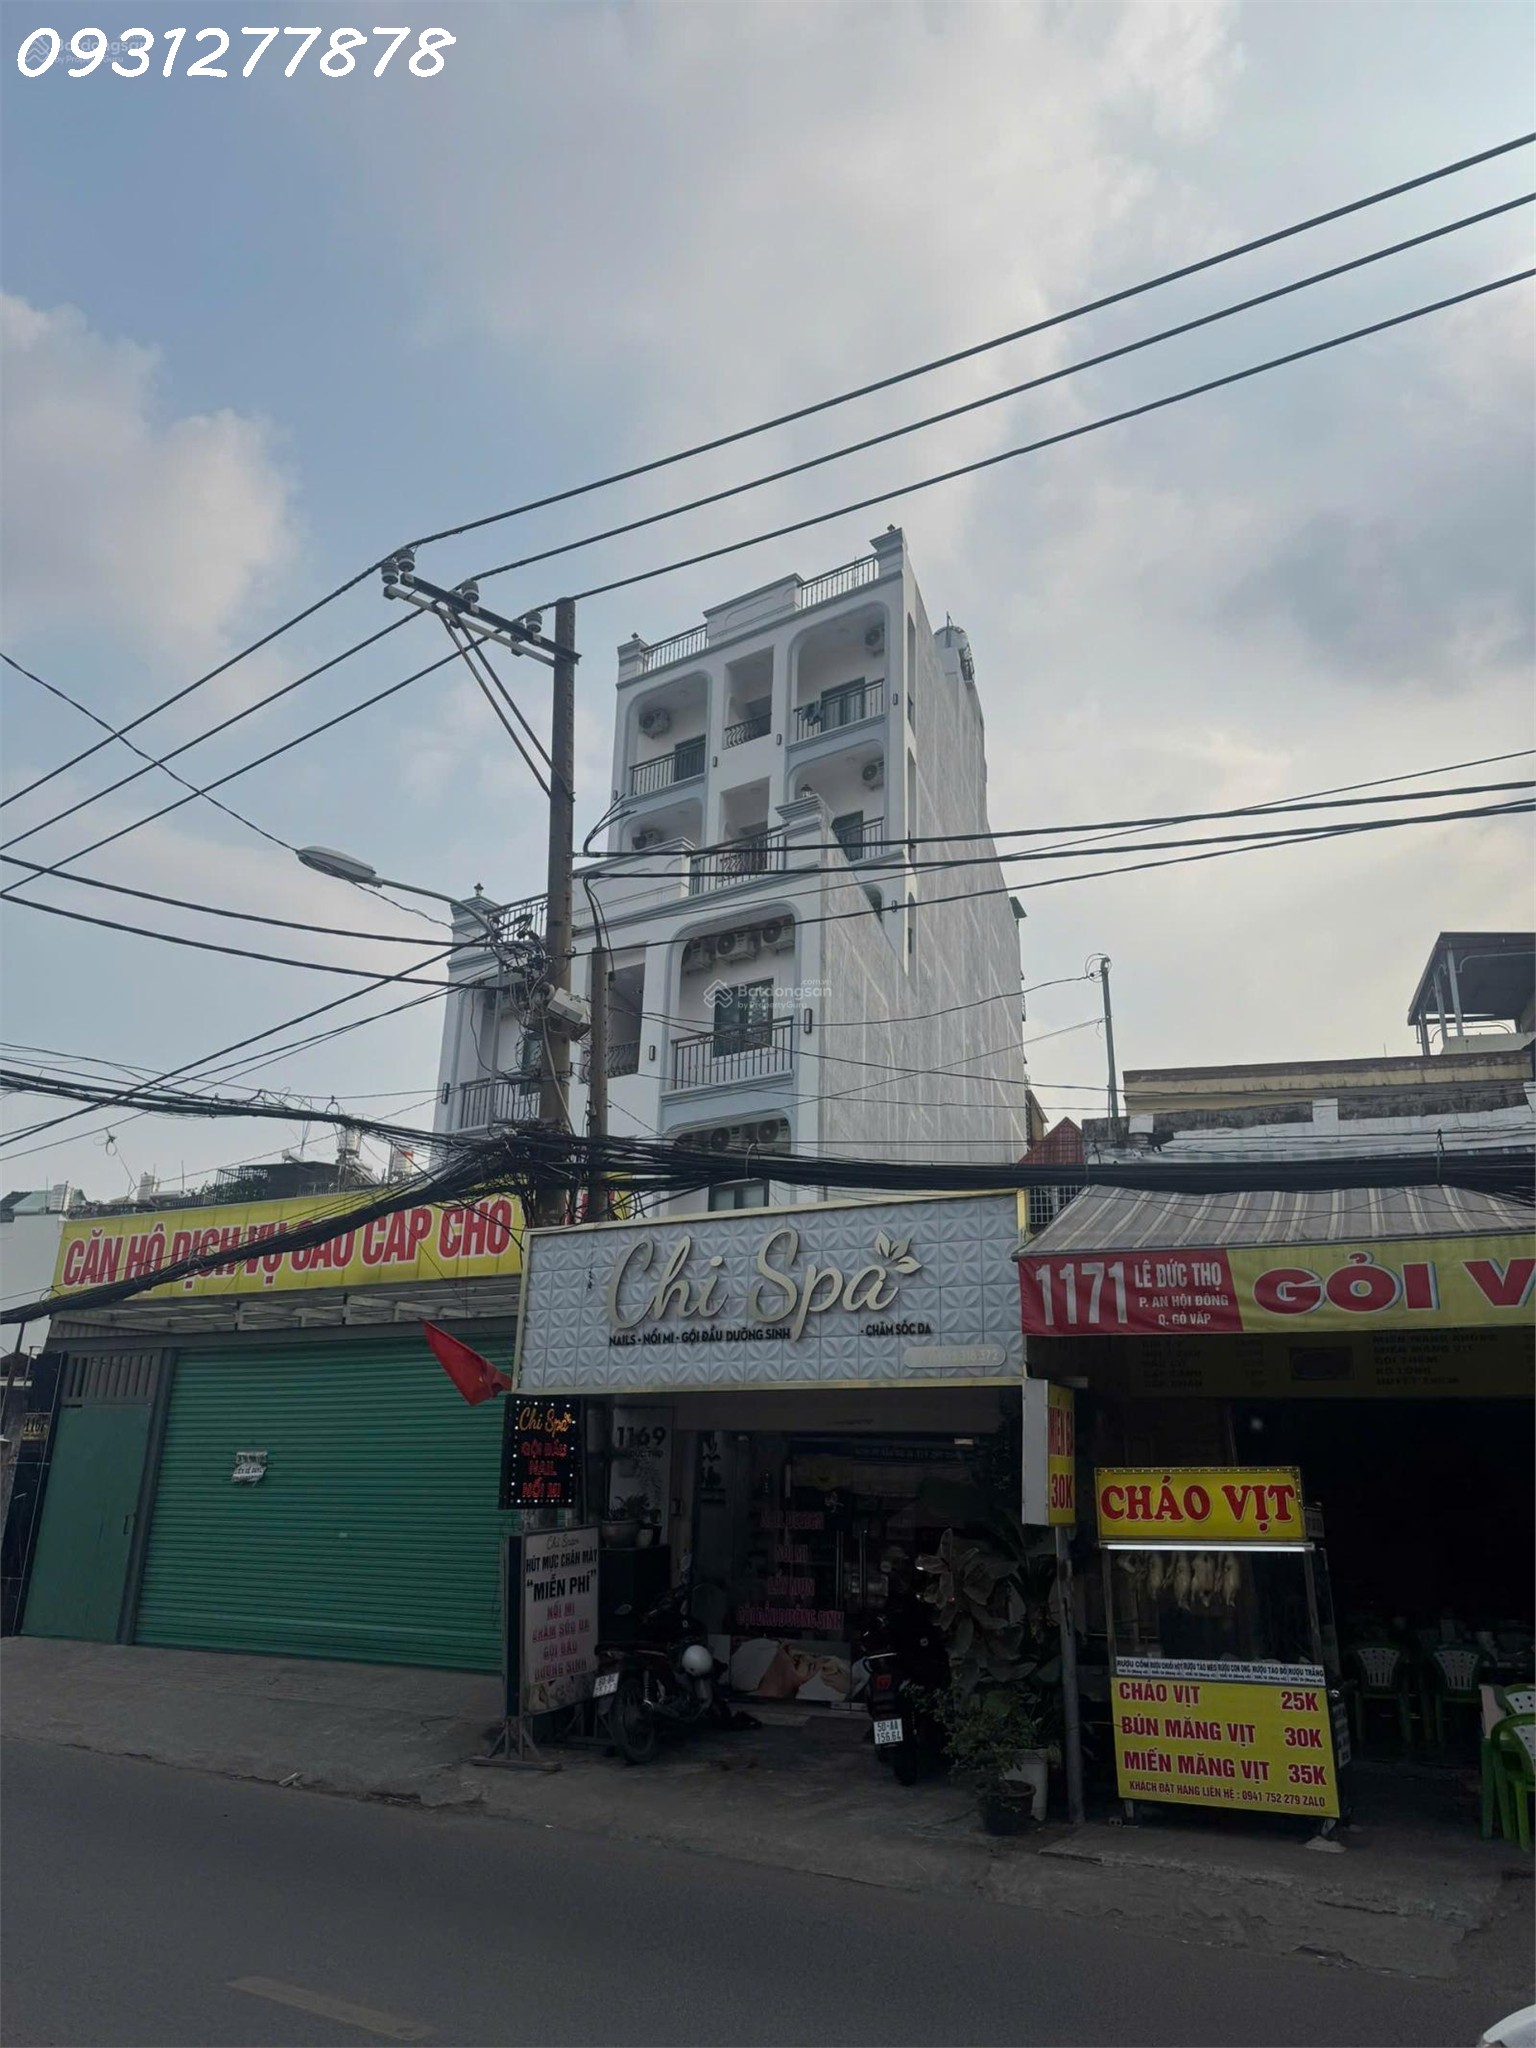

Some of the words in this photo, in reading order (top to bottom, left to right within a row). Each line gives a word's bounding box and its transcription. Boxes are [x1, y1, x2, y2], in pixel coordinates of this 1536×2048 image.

[62, 1229, 123, 1286] CĂN
[608, 1234, 729, 1330] Chi
[749, 1227, 901, 1343] Spa
[1036, 1261, 1129, 1326] 1171
[1134, 1260, 1153, 1289] LÊ
[1156, 1258, 1187, 1288] ĐỨC
[1191, 1261, 1222, 1292] THỌ
[1252, 1250, 1440, 1317] GỎI
[1139, 1298, 1150, 1308] P.
[1152, 1296, 1169, 1308] AN
[917, 1322, 933, 1335] DA
[1158, 1313, 1170, 1326] Q.
[609, 1333, 636, 1347] NAILS
[663, 1331, 675, 1345] MI
[765, 1327, 791, 1340] SINH
[520, 1406, 543, 1432] Chi
[545, 1407, 571, 1437] Spa
[617, 1426, 667, 1446] 1169
[1051, 1474, 1073, 1509] 30K
[1101, 1475, 1211, 1521] CHÁO
[1220, 1484, 1296, 1533] VỊT
[1119, 1678, 1168, 1703] CHÁO
[1173, 1685, 1200, 1708] VỊT
[1281, 1690, 1319, 1712] 25K
[1121, 1713, 1160, 1737] BÚN
[1165, 1716, 1222, 1741] MĂNG
[1227, 1723, 1256, 1747] VỊT
[1284, 1727, 1324, 1749] 30K
[1124, 1747, 1172, 1773] MIẾN
[1178, 1752, 1236, 1779] MĂNG
[1241, 1759, 1270, 1785] VỊT
[1288, 1763, 1328, 1786] 35K
[1242, 1791, 1263, 1802] 0941
[1265, 1793, 1283, 1804] 752
[1283, 1794, 1301, 1805] 279
[1302, 1795, 1327, 1808] ZALO
